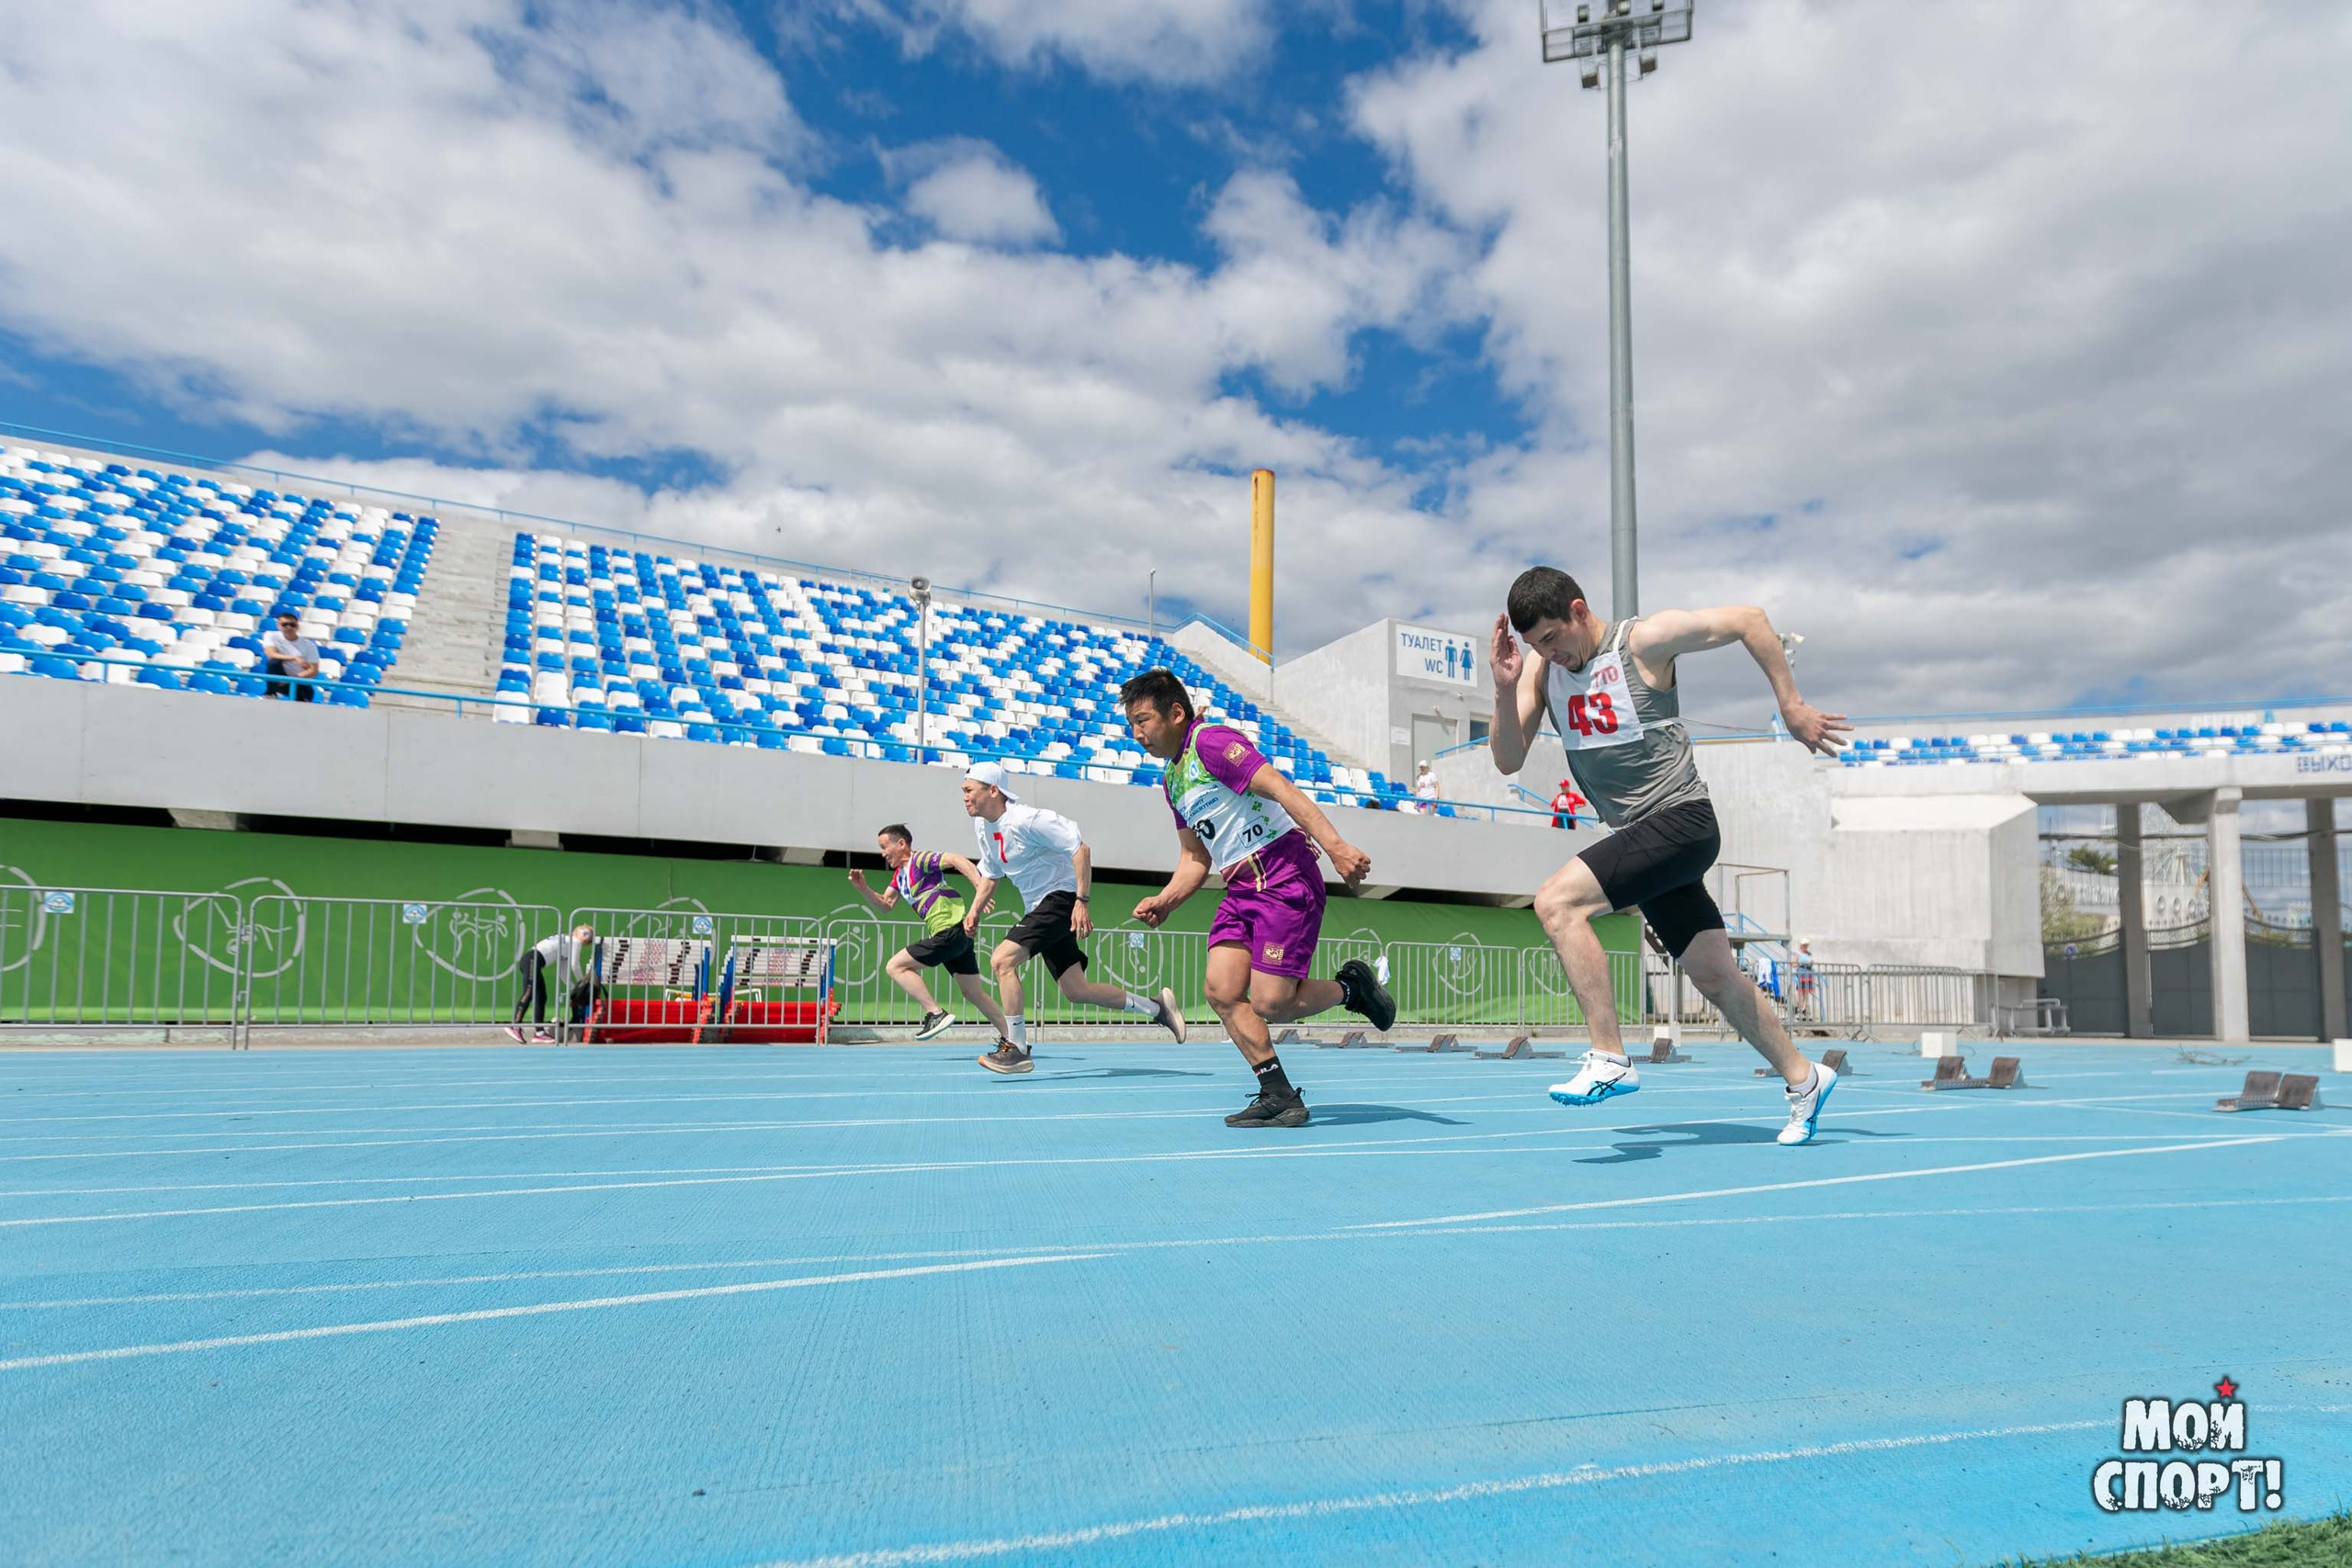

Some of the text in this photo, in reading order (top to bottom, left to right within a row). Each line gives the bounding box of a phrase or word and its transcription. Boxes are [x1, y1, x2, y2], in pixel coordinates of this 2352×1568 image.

[1401, 632, 1443, 652] ТУАЛЕТ
[1424, 658, 1443, 674] WC
[1567, 692, 1619, 737] 43
[1241, 823, 1263, 843] 70
[993, 831, 1009, 863] 7
